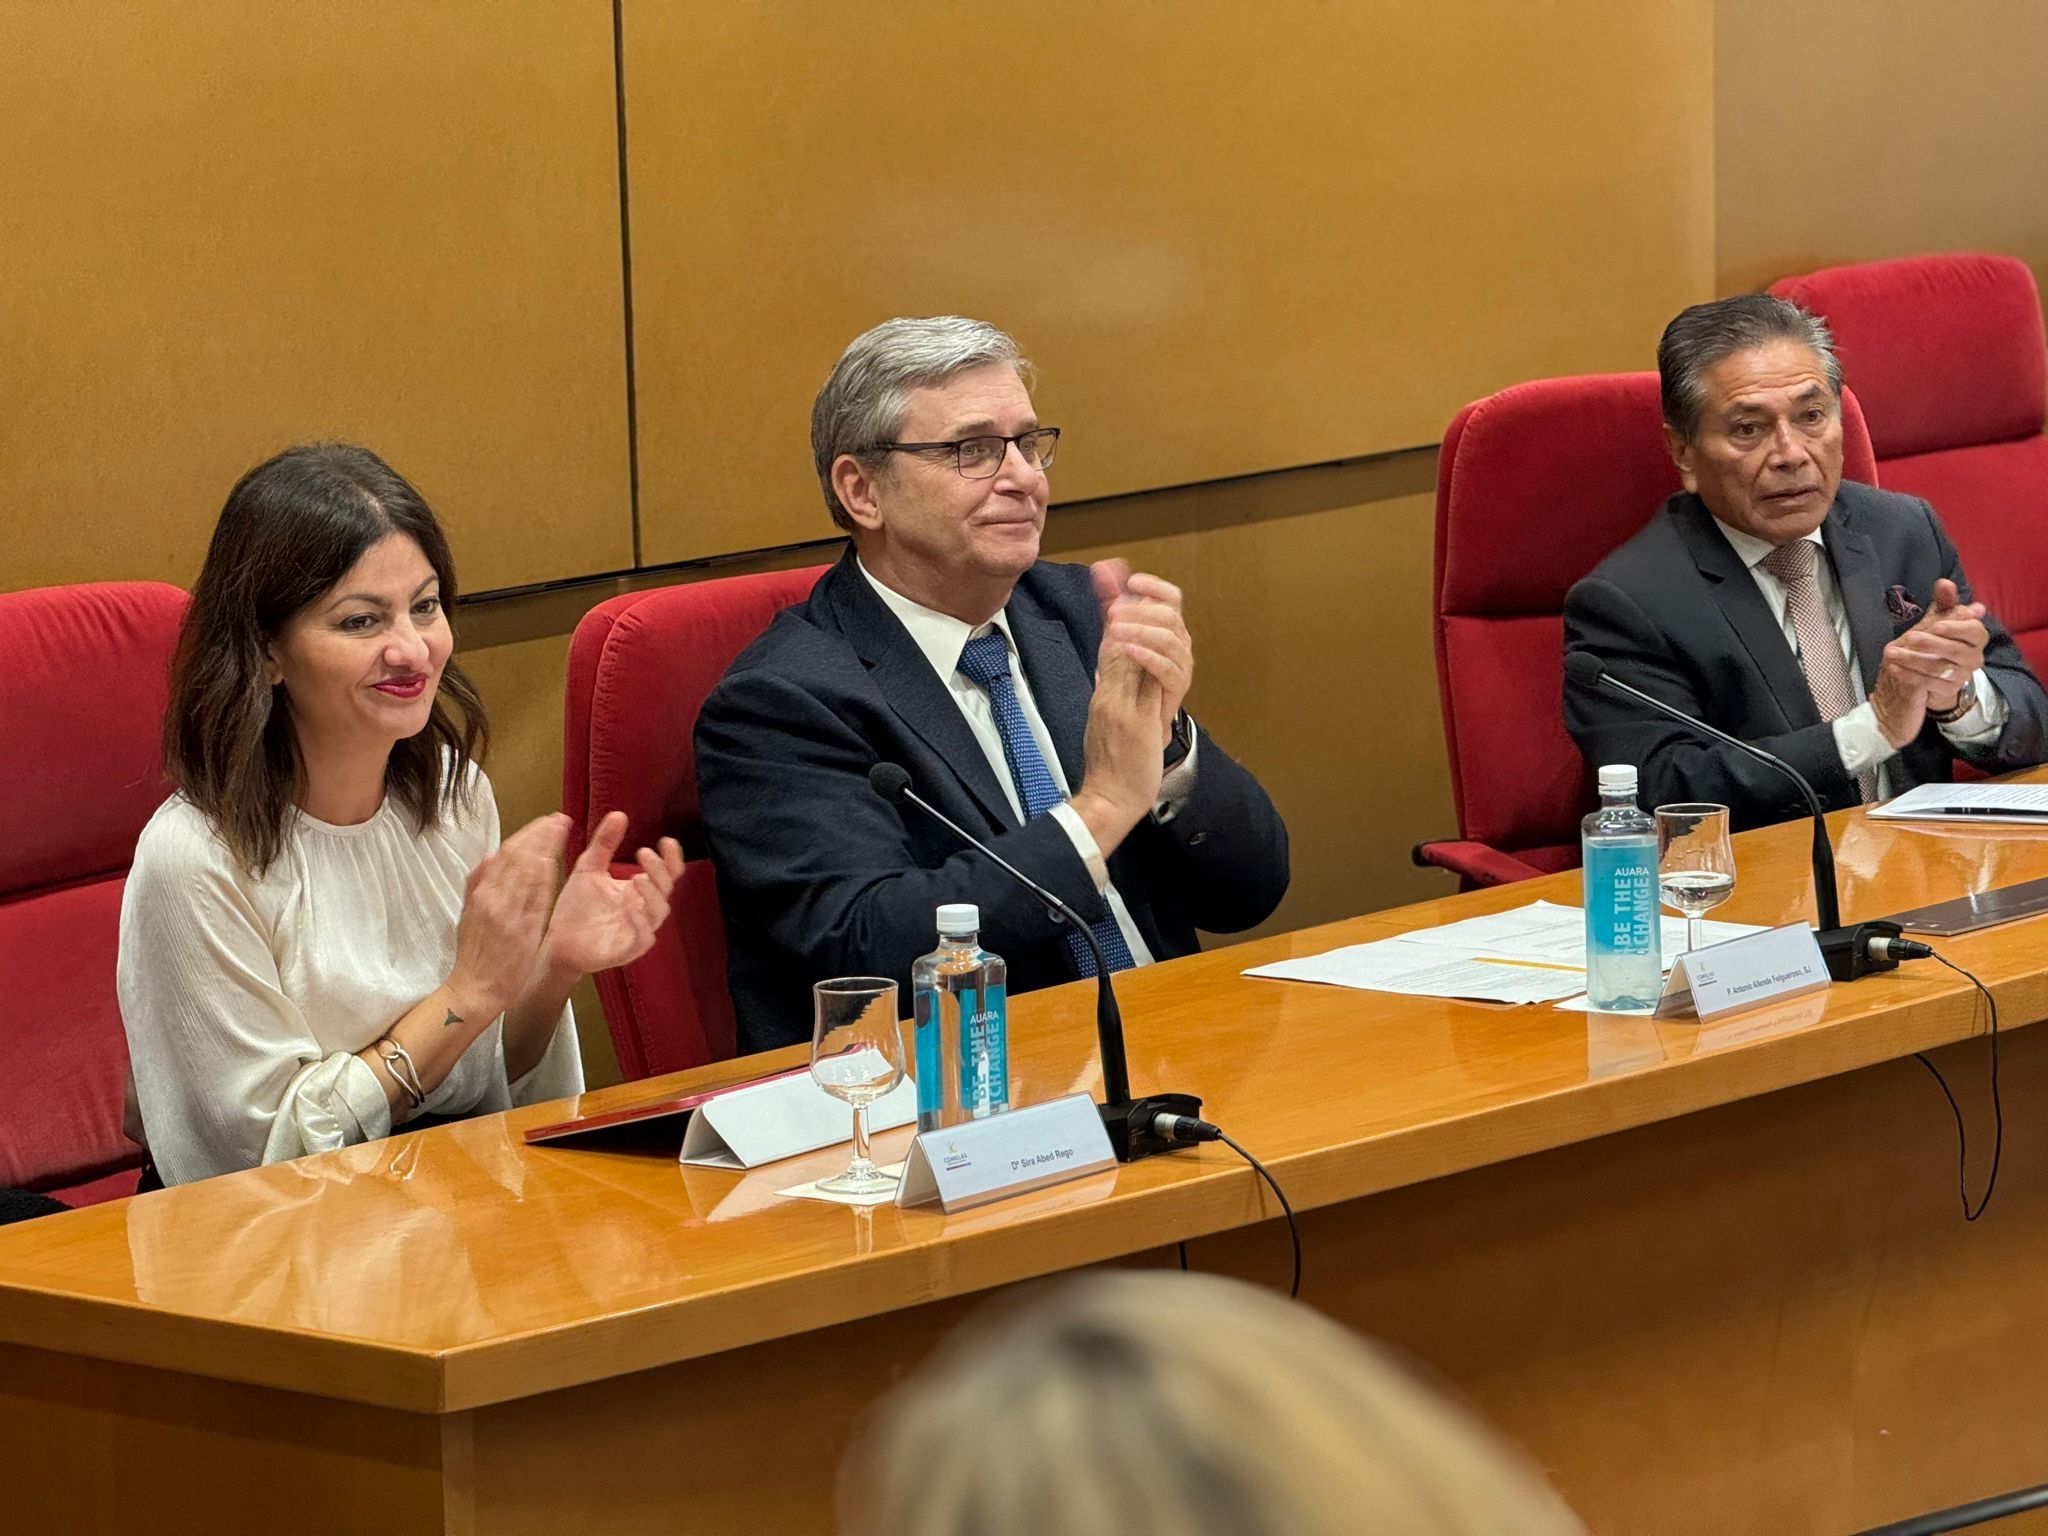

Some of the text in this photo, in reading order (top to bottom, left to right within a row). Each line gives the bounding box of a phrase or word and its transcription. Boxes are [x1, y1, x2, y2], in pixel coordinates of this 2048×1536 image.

[1614, 866, 1650, 877] AUARA
[1614, 878, 1632, 946] BE THE
[1633, 877, 1650, 946] CHANGE
[1733, 983, 1753, 995] Antonio
[1753, 978, 1772, 989] Allende
[970, 1010, 1000, 1025] AUARA
[971, 1023, 986, 1067] THE
[985, 1021, 1002, 1098] CHANGE
[1021, 1157, 1036, 1169] Sira
[1036, 1152, 1055, 1164] Abed
[1055, 1147, 1074, 1160] Rego
